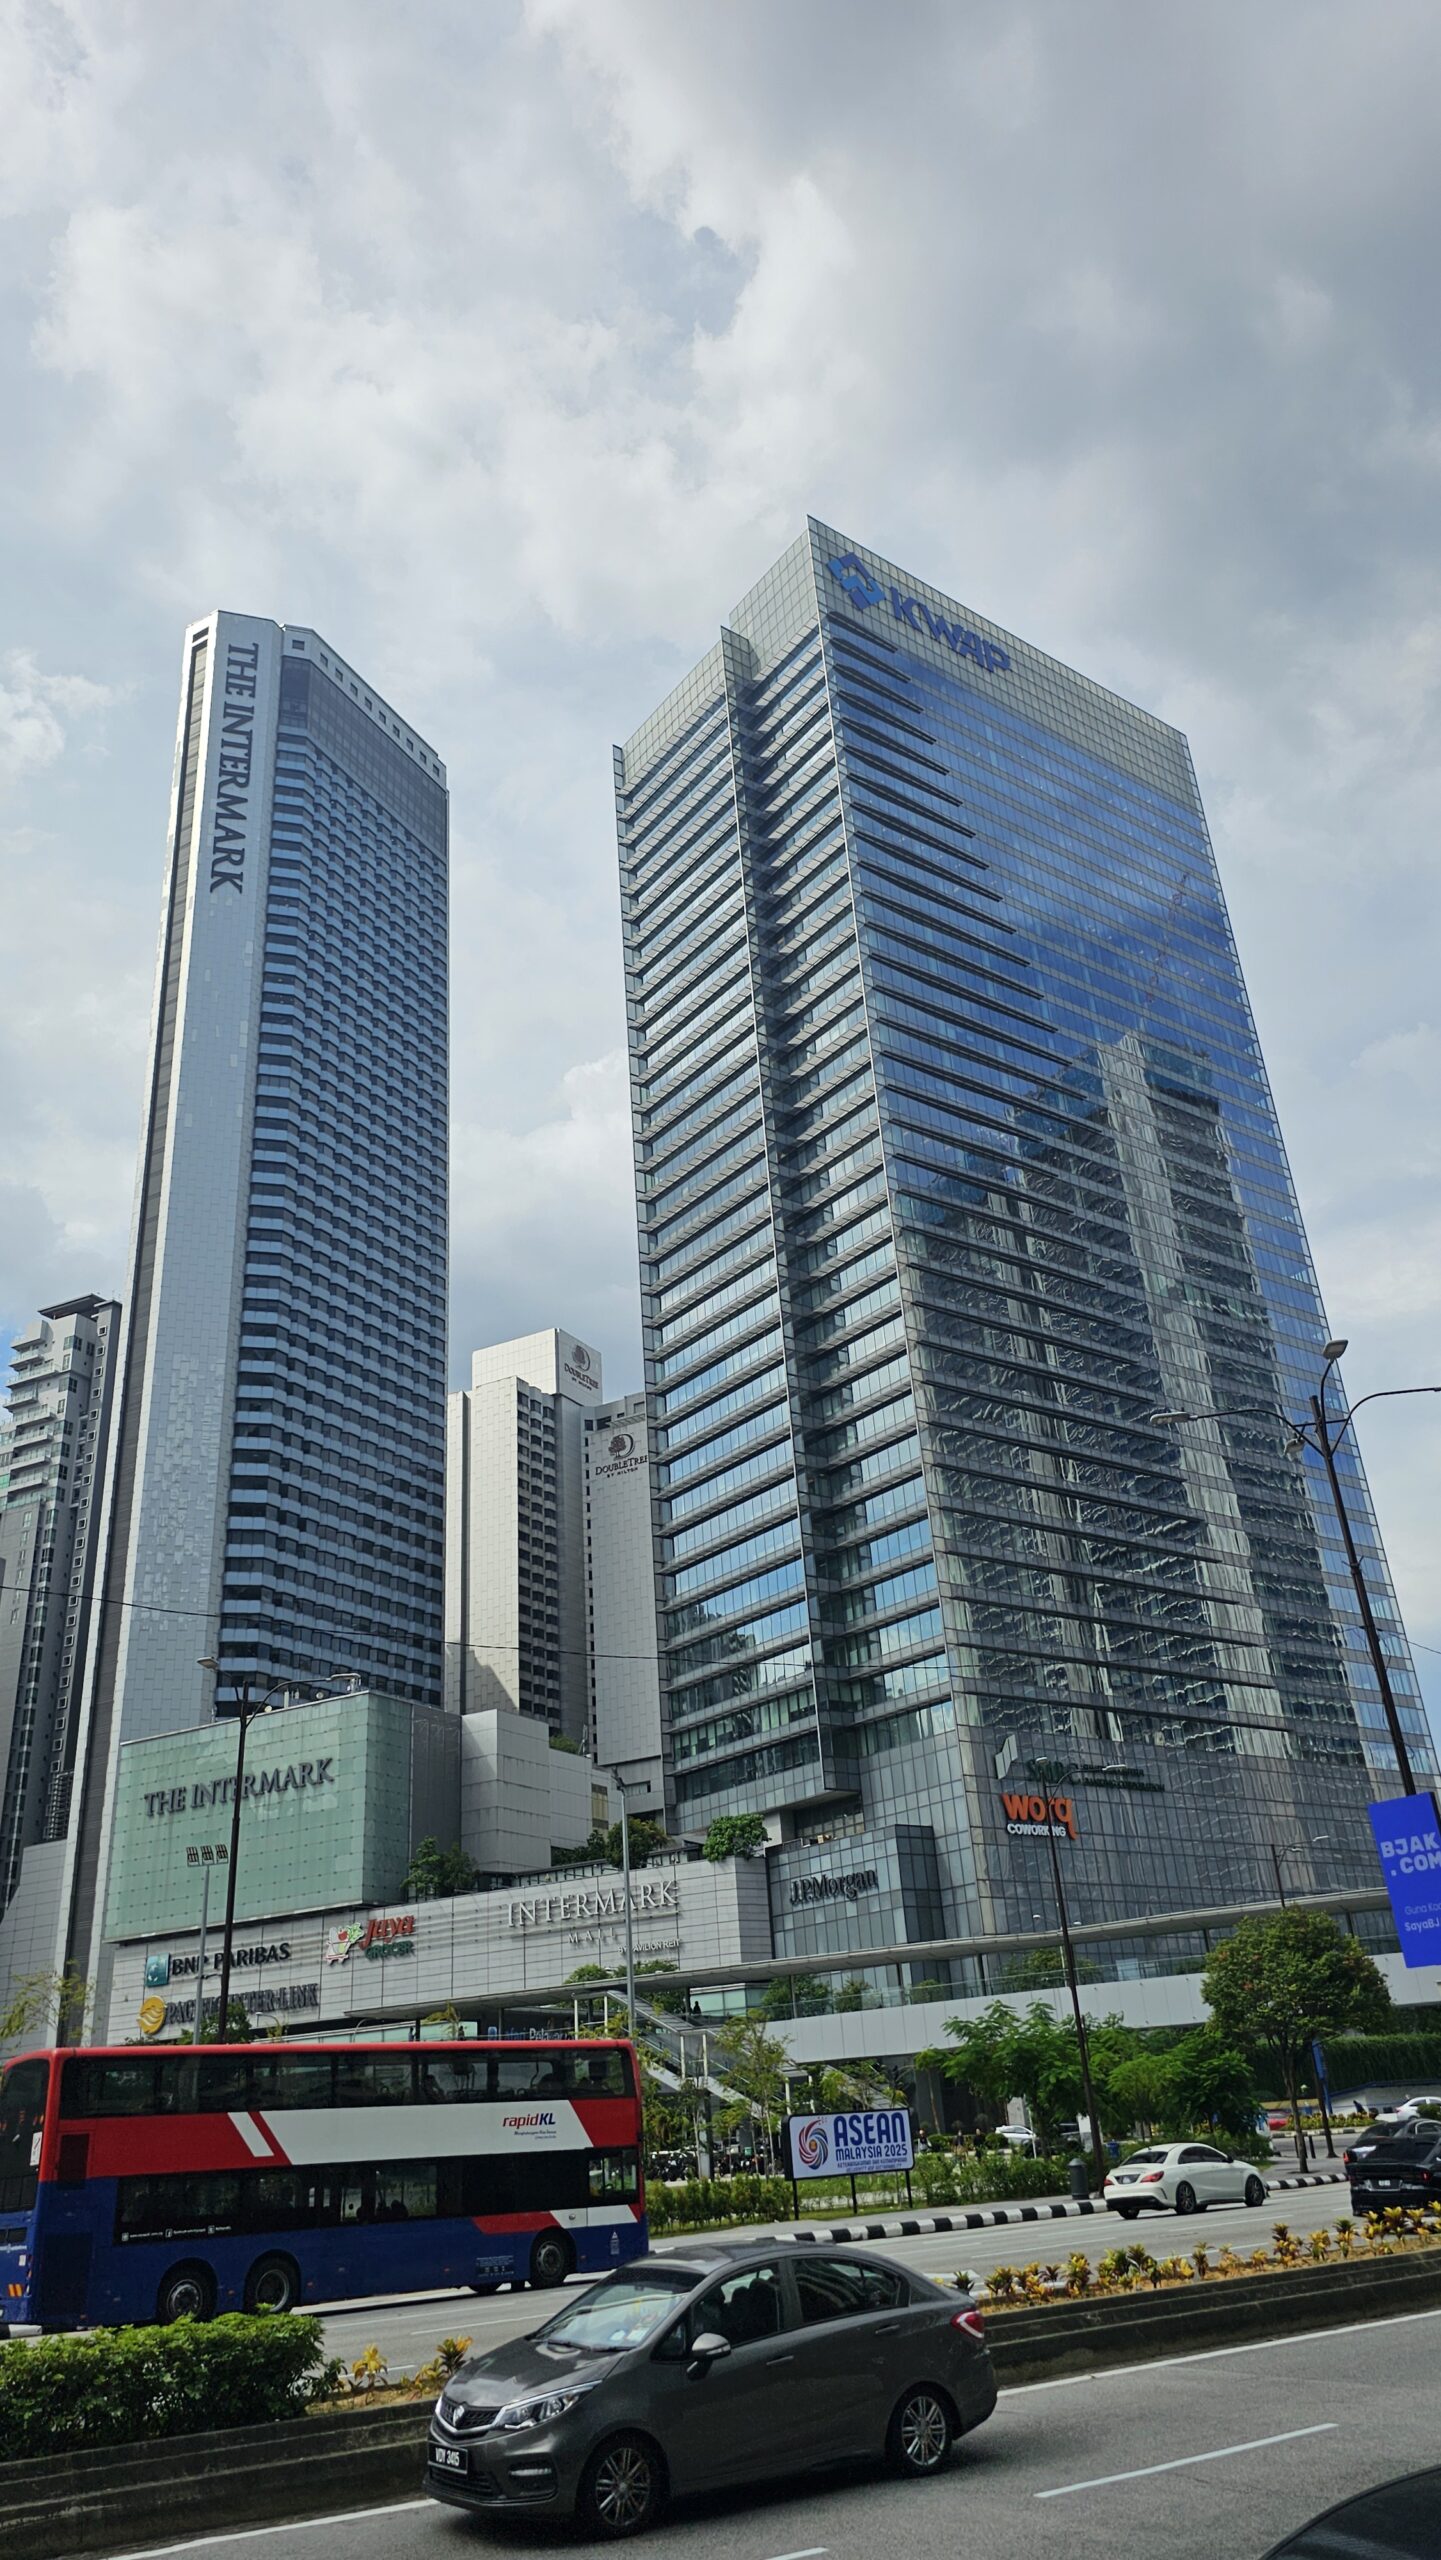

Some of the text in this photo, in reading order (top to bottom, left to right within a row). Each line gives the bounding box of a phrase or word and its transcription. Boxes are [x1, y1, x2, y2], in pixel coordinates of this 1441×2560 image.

[890, 586, 1011, 673] KWAP
[210, 642, 259, 894] THE INTERMARK
[144, 1757, 335, 1817] THE INTERMARK
[1007, 1823, 1066, 1837] COWORKNG
[1380, 1832, 1440, 1858] BJAK
[508, 1880, 678, 1927] INTERMARK
[359, 1915, 415, 1951] Jaya
[568, 1927, 616, 1944] MALL
[632, 1941, 661, 1952] AVILION
[172, 1955, 209, 1976] BNP
[165, 1996, 222, 2024] PACFIC
[502, 2112, 556, 2129] rapidKL
[833, 2112, 906, 2147] ASEAN
[835, 2144, 908, 2161] MALAYSIA 2025
